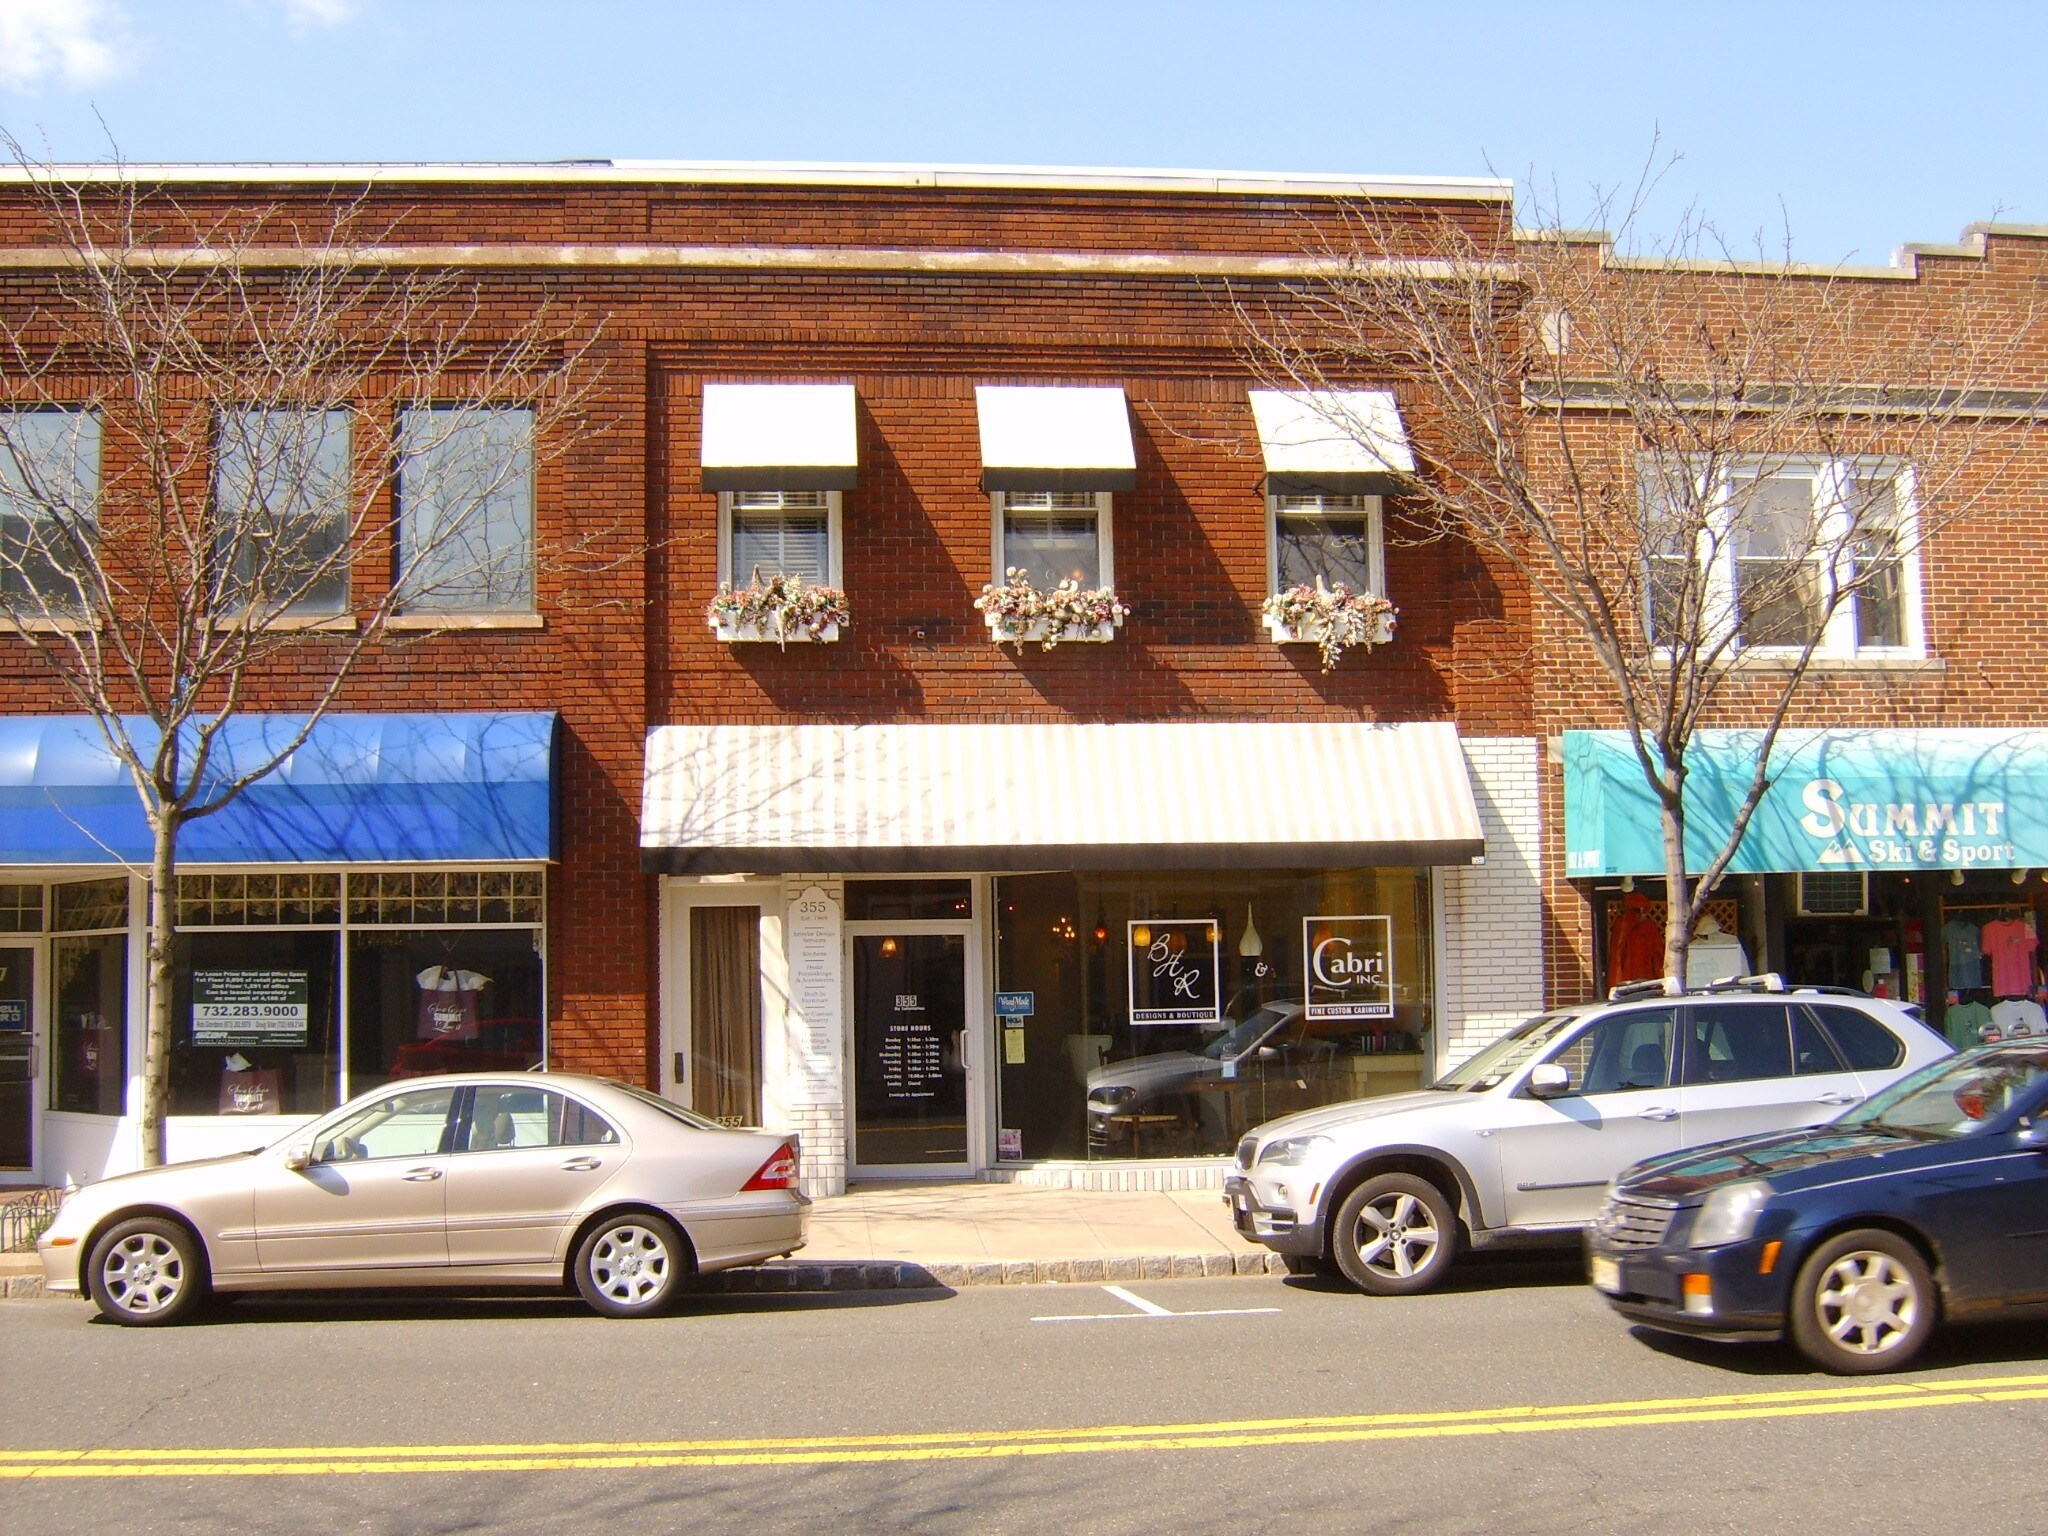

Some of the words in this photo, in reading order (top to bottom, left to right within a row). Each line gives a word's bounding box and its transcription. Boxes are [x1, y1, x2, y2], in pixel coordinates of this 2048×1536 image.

[1800, 778, 2004, 838] SUMMIT
[1869, 839, 1914, 863] Ski
[1917, 839, 1937, 862] &
[1942, 838, 2015, 867] Sport
[800, 901, 826, 913] 355
[1312, 937, 1383, 986] Cabri
[1254, 962, 1268, 977] &
[1356, 974, 1384, 984] INC.
[895, 995, 917, 1007] 355
[202, 1006, 299, 1017] 732.283.9000
[1135, 1012, 1167, 1020] DESIGNS
[1176, 1011, 1214, 1019] BOUTIQUE
[1311, 1007, 1326, 1015] FINE
[1327, 1006, 1352, 1014] CUSTOM
[1354, 1006, 1387, 1014] CABINETRY
